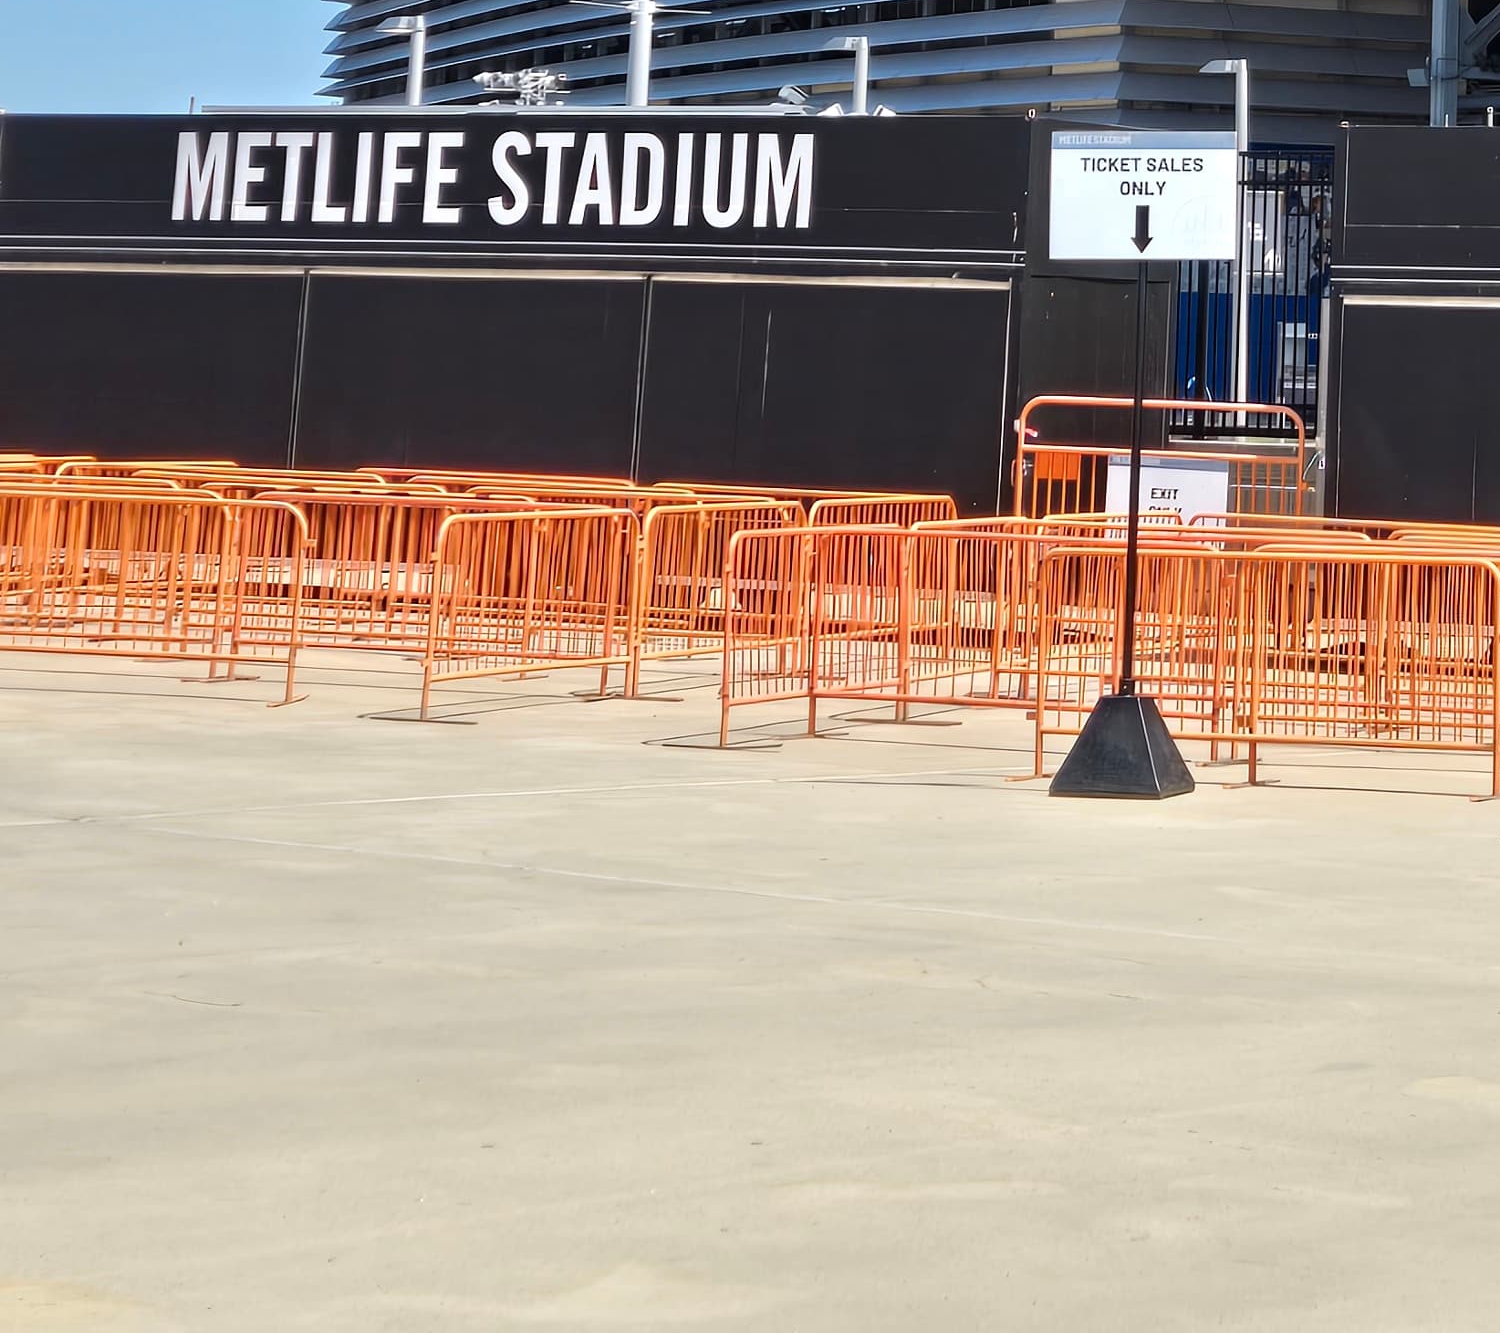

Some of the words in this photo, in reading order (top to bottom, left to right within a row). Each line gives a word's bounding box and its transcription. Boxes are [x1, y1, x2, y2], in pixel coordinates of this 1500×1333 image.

[1080, 157, 1141, 172] TICKET
[1146, 157, 1204, 172] SALES
[171, 131, 465, 224] METLIFE
[487, 130, 815, 229] STADIUM
[1120, 181, 1166, 196] ONLY
[1150, 487, 1179, 500] EXIT
